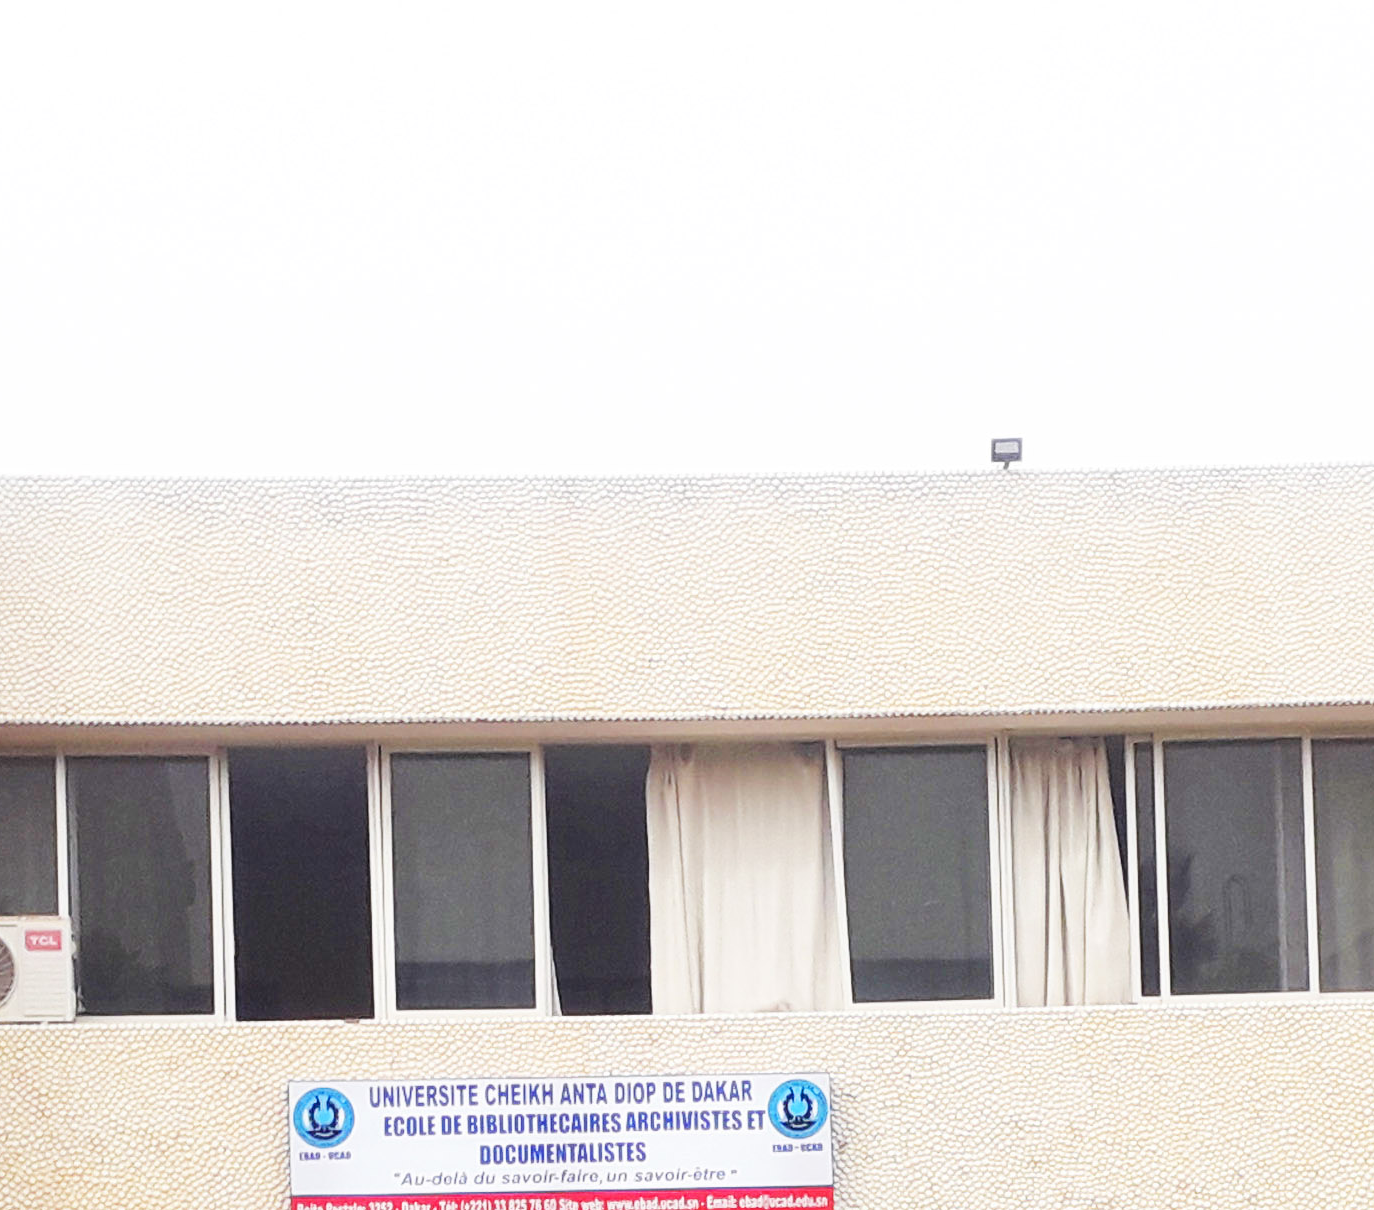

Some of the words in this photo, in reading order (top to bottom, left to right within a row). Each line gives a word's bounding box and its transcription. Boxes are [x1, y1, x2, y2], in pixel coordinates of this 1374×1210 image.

[29, 935, 59, 946] TCL
[369, 1084, 479, 1107] UNIVERSITE
[485, 1083, 554, 1106] CHEIKH
[560, 1082, 608, 1105] ANTA
[614, 1081, 656, 1104] DIOP
[663, 1081, 686, 1103] DE
[692, 1080, 753, 1102] DAKAR
[384, 1115, 436, 1136] ECOLE
[441, 1115, 462, 1136] DE
[467, 1112, 622, 1135] BIBLIOTHECAIRES
[627, 1110, 743, 1132] ARCHIVISTES
[747, 1110, 766, 1131] ET
[480, 1141, 647, 1165] DOCUMENTALISTES
[474, 1171, 495, 1185] du
[606, 1173, 628, 1183] un
